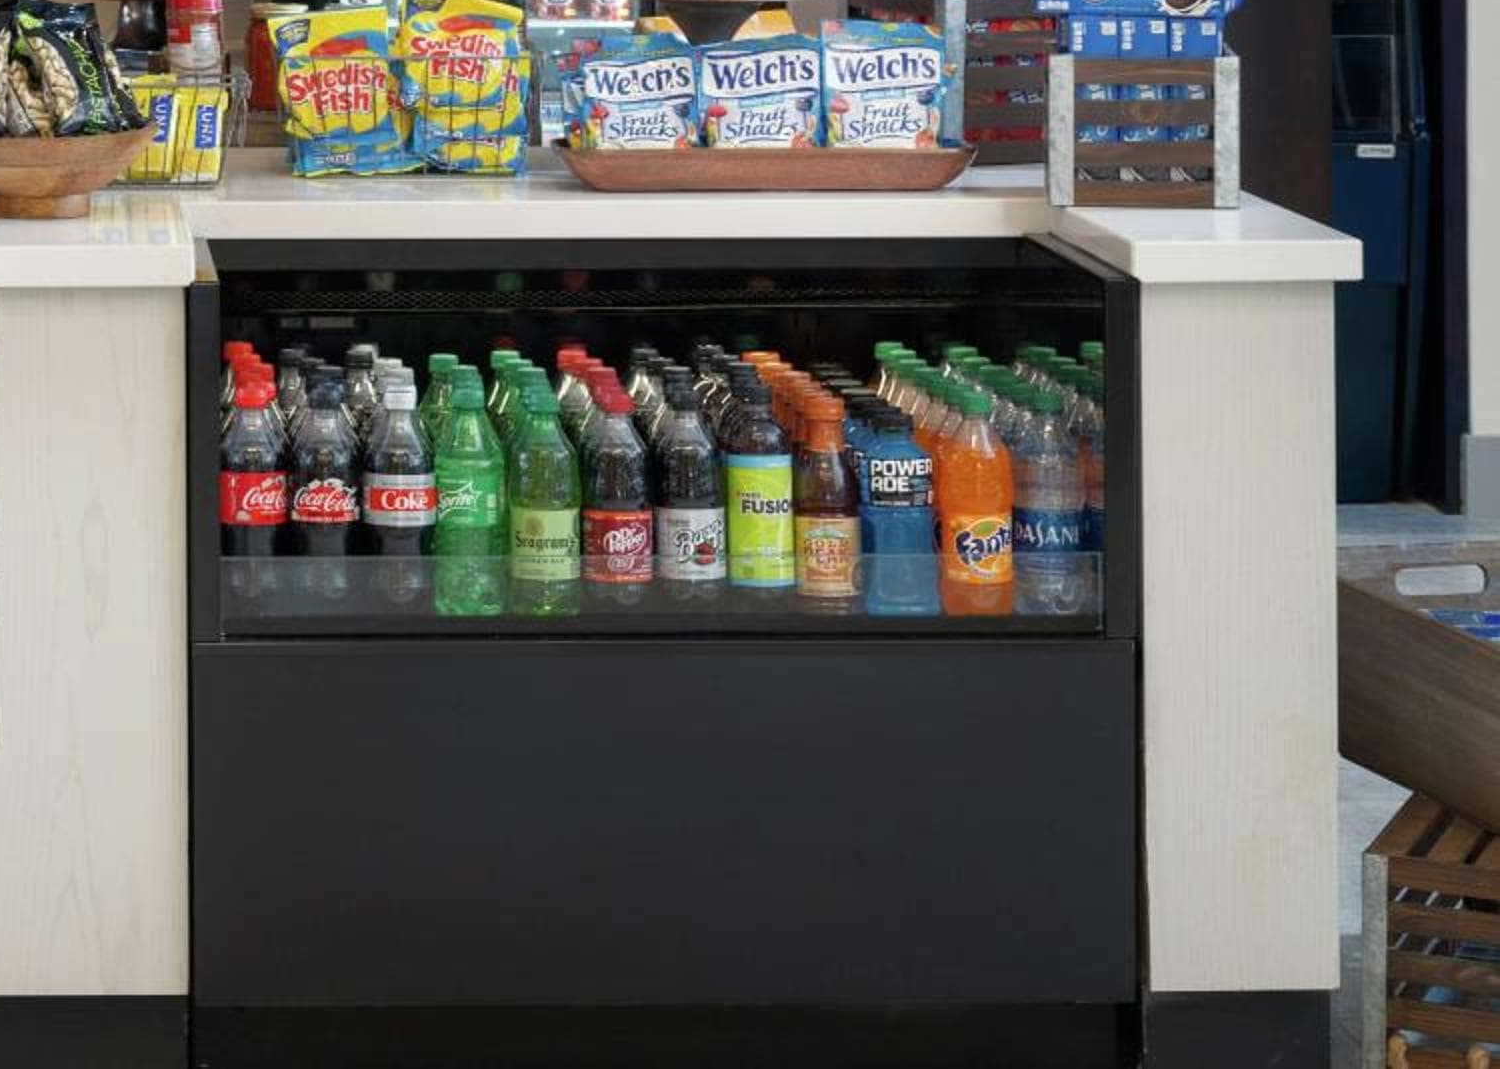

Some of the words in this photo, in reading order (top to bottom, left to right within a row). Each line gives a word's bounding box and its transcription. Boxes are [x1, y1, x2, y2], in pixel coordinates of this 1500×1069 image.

[429, 51, 486, 83] Fish
[708, 48, 816, 91] Welch's
[831, 46, 937, 85] Welch's
[285, 61, 387, 104] Swedish
[589, 61, 692, 96] Welch's
[310, 83, 372, 116] Fish
[620, 110, 669, 127] Fruit
[739, 105, 788, 125] Fruit
[862, 103, 912, 121] Fruit
[199, 105, 215, 146] LUNA
[609, 121, 680, 139] Snacks
[725, 118, 798, 139] Snacks
[848, 114, 923, 138] Snacks
[870, 459, 933, 476] POWER
[870, 476, 910, 492] ADE
[294, 482, 358, 512] Coca-Cola
[380, 491, 430, 511] Coke
[740, 499, 790, 515] FUSIO
[607, 531, 647, 554] Pepper
